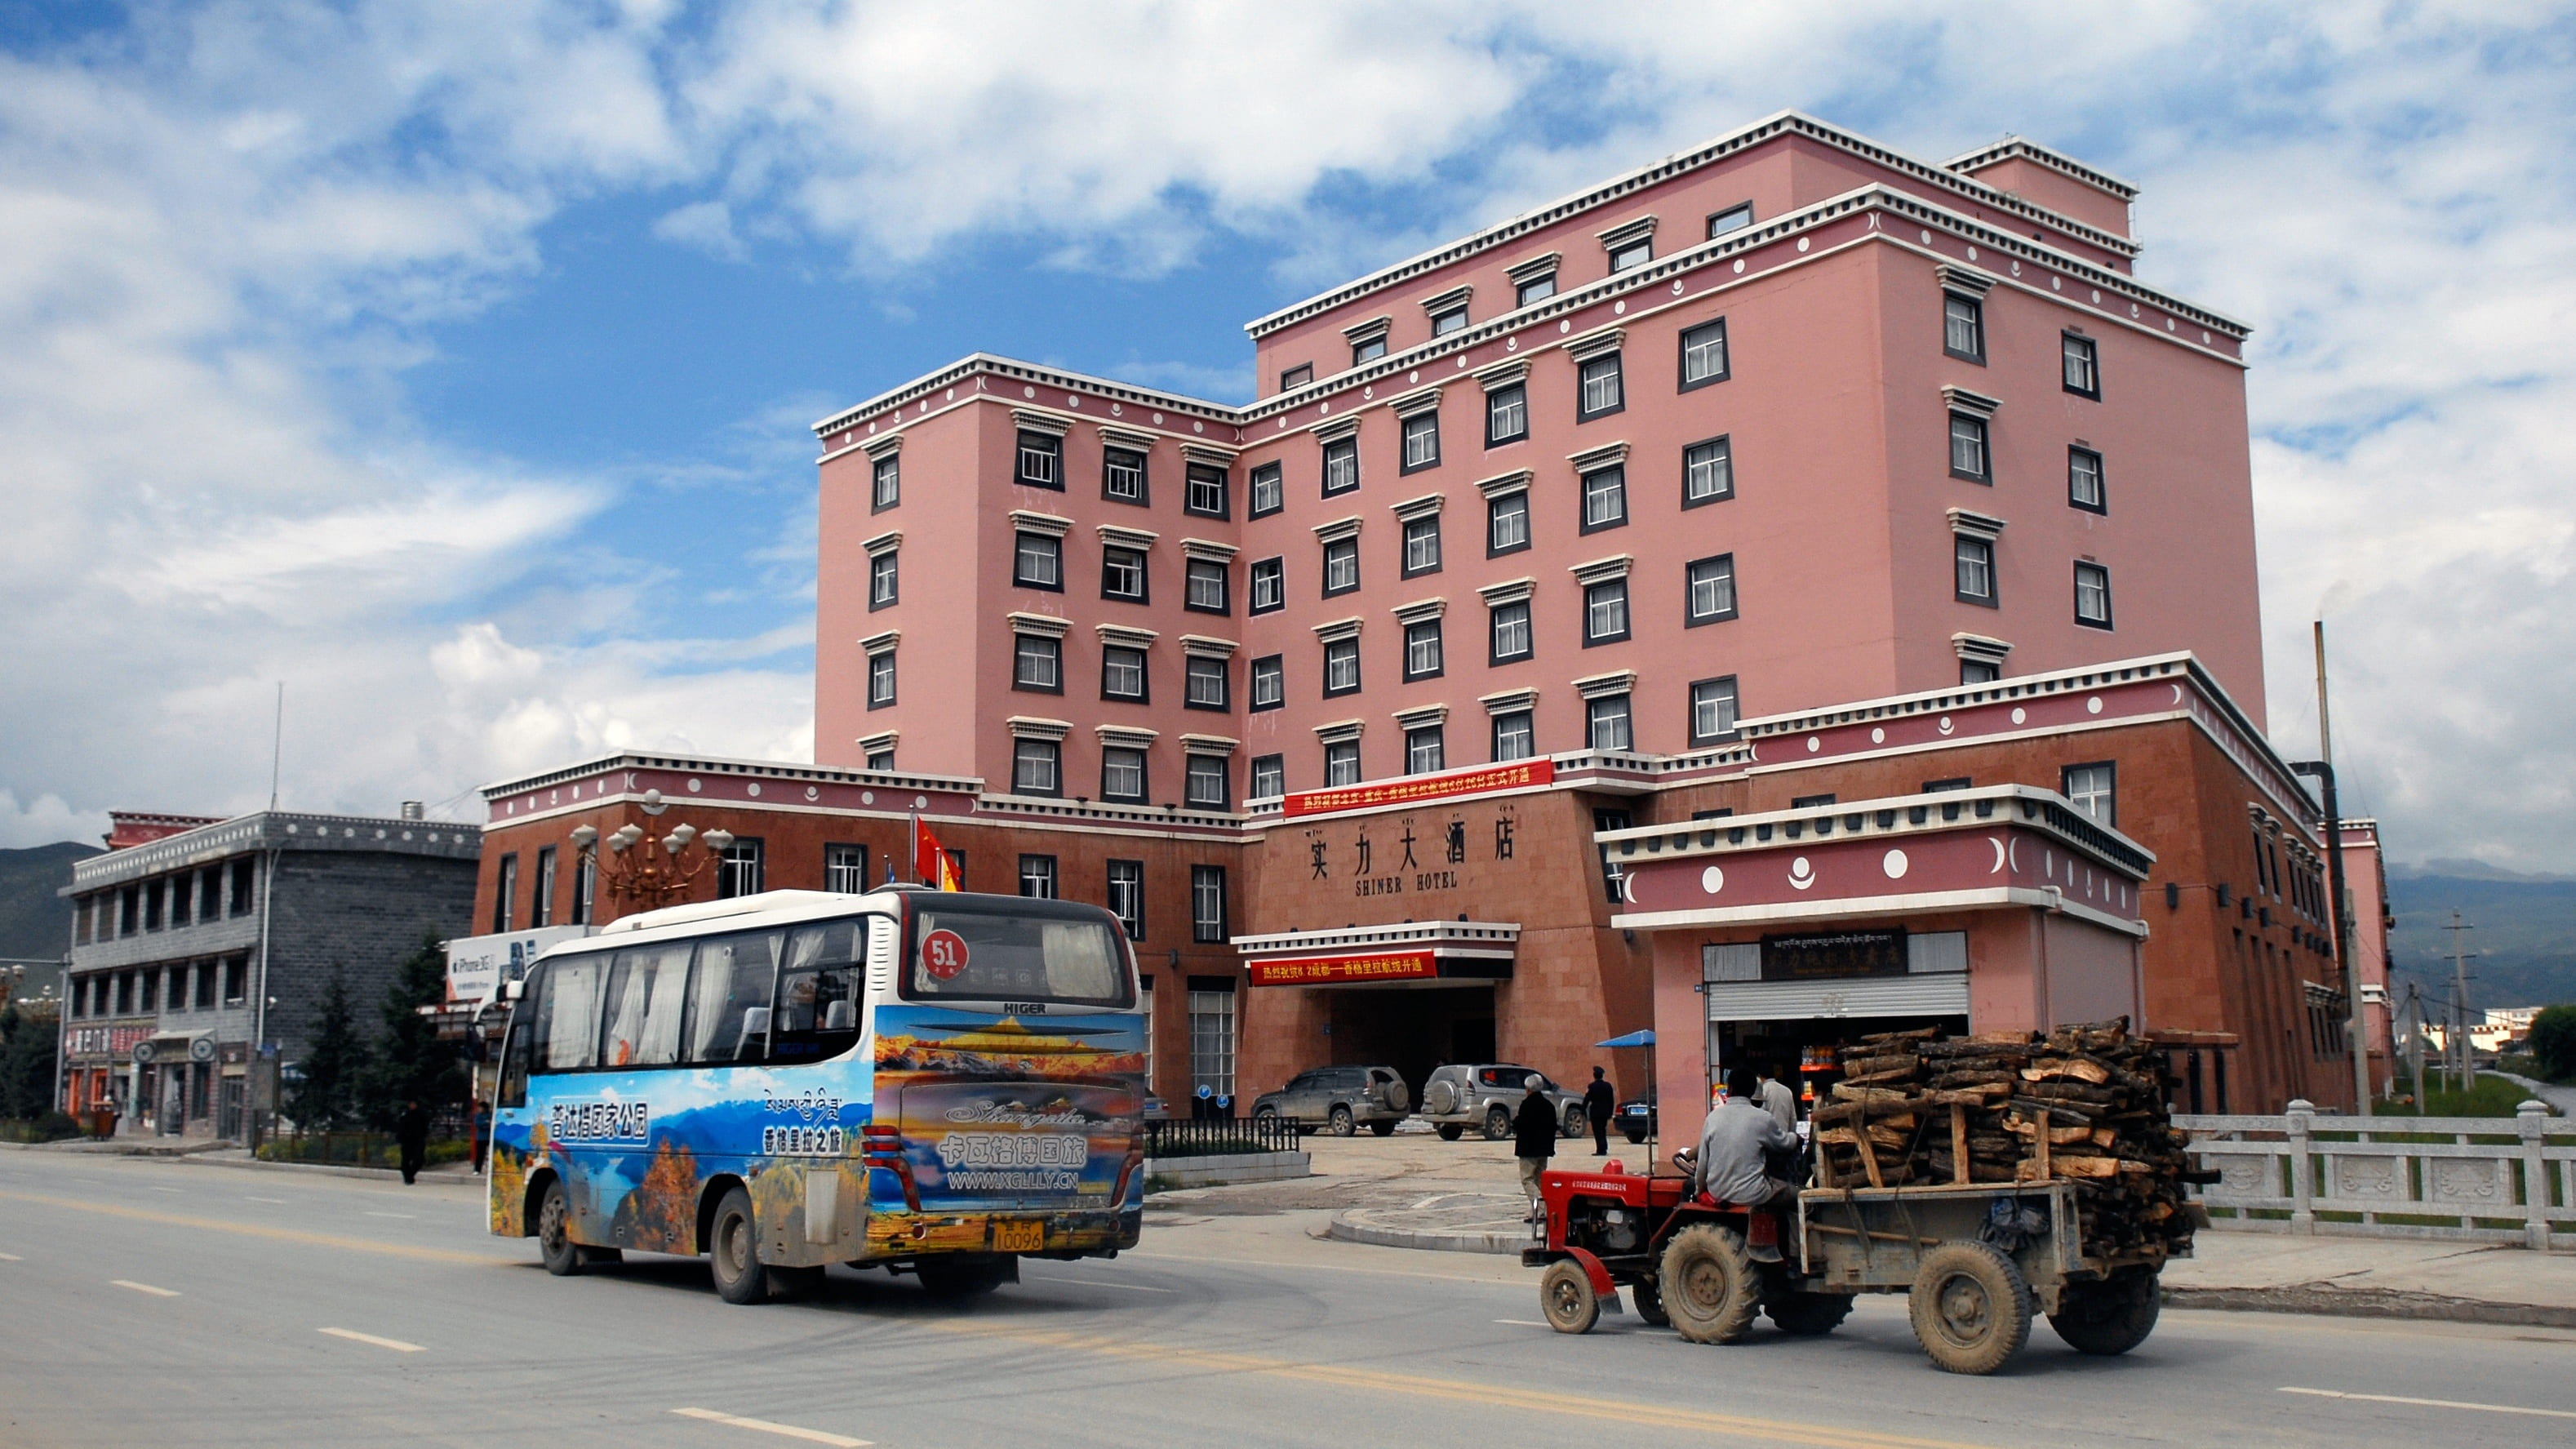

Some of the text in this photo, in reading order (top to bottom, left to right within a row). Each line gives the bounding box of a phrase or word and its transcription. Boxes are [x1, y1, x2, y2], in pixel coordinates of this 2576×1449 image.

[1311, 817, 1514, 880] 实力大酒店
[1355, 871, 1457, 896] SHINER HOTEL
[932, 940, 957, 966] 51
[1004, 1002, 1046, 1014] HIGER
[552, 1102, 648, 1138] 普达措国家公园
[764, 1128, 841, 1153] 香格里拉之旅
[939, 1136, 1086, 1164] 卡瓦格博国旅
[948, 1172, 1079, 1189] WWW.XGLLLY.CN
[997, 1233, 1041, 1250] 10096
